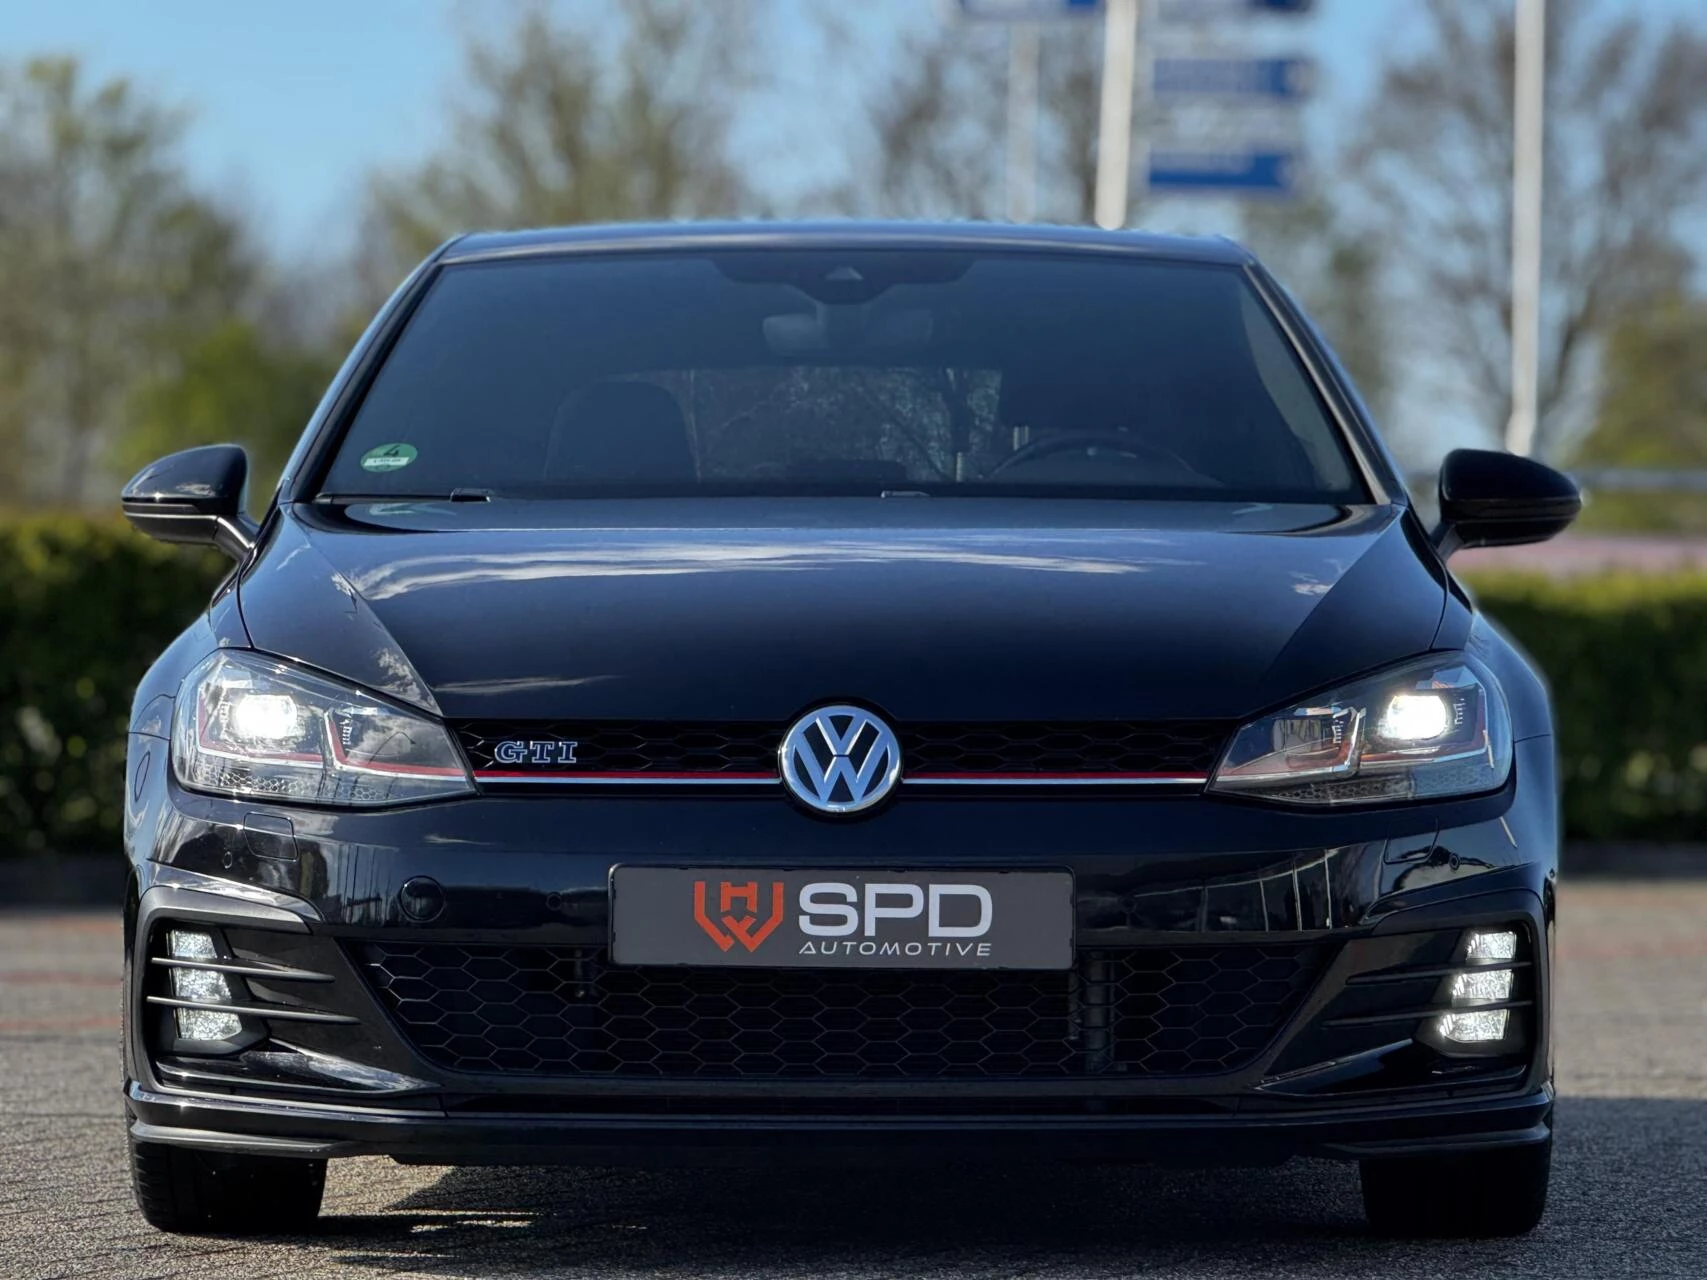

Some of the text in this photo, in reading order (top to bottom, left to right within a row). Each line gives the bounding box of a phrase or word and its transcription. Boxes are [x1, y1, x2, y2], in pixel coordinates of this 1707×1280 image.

[383, 444, 401, 457] 4
[494, 741, 578, 764] GTI
[799, 883, 993, 937] SPD
[799, 941, 992, 956] AUTOMOTIVE
